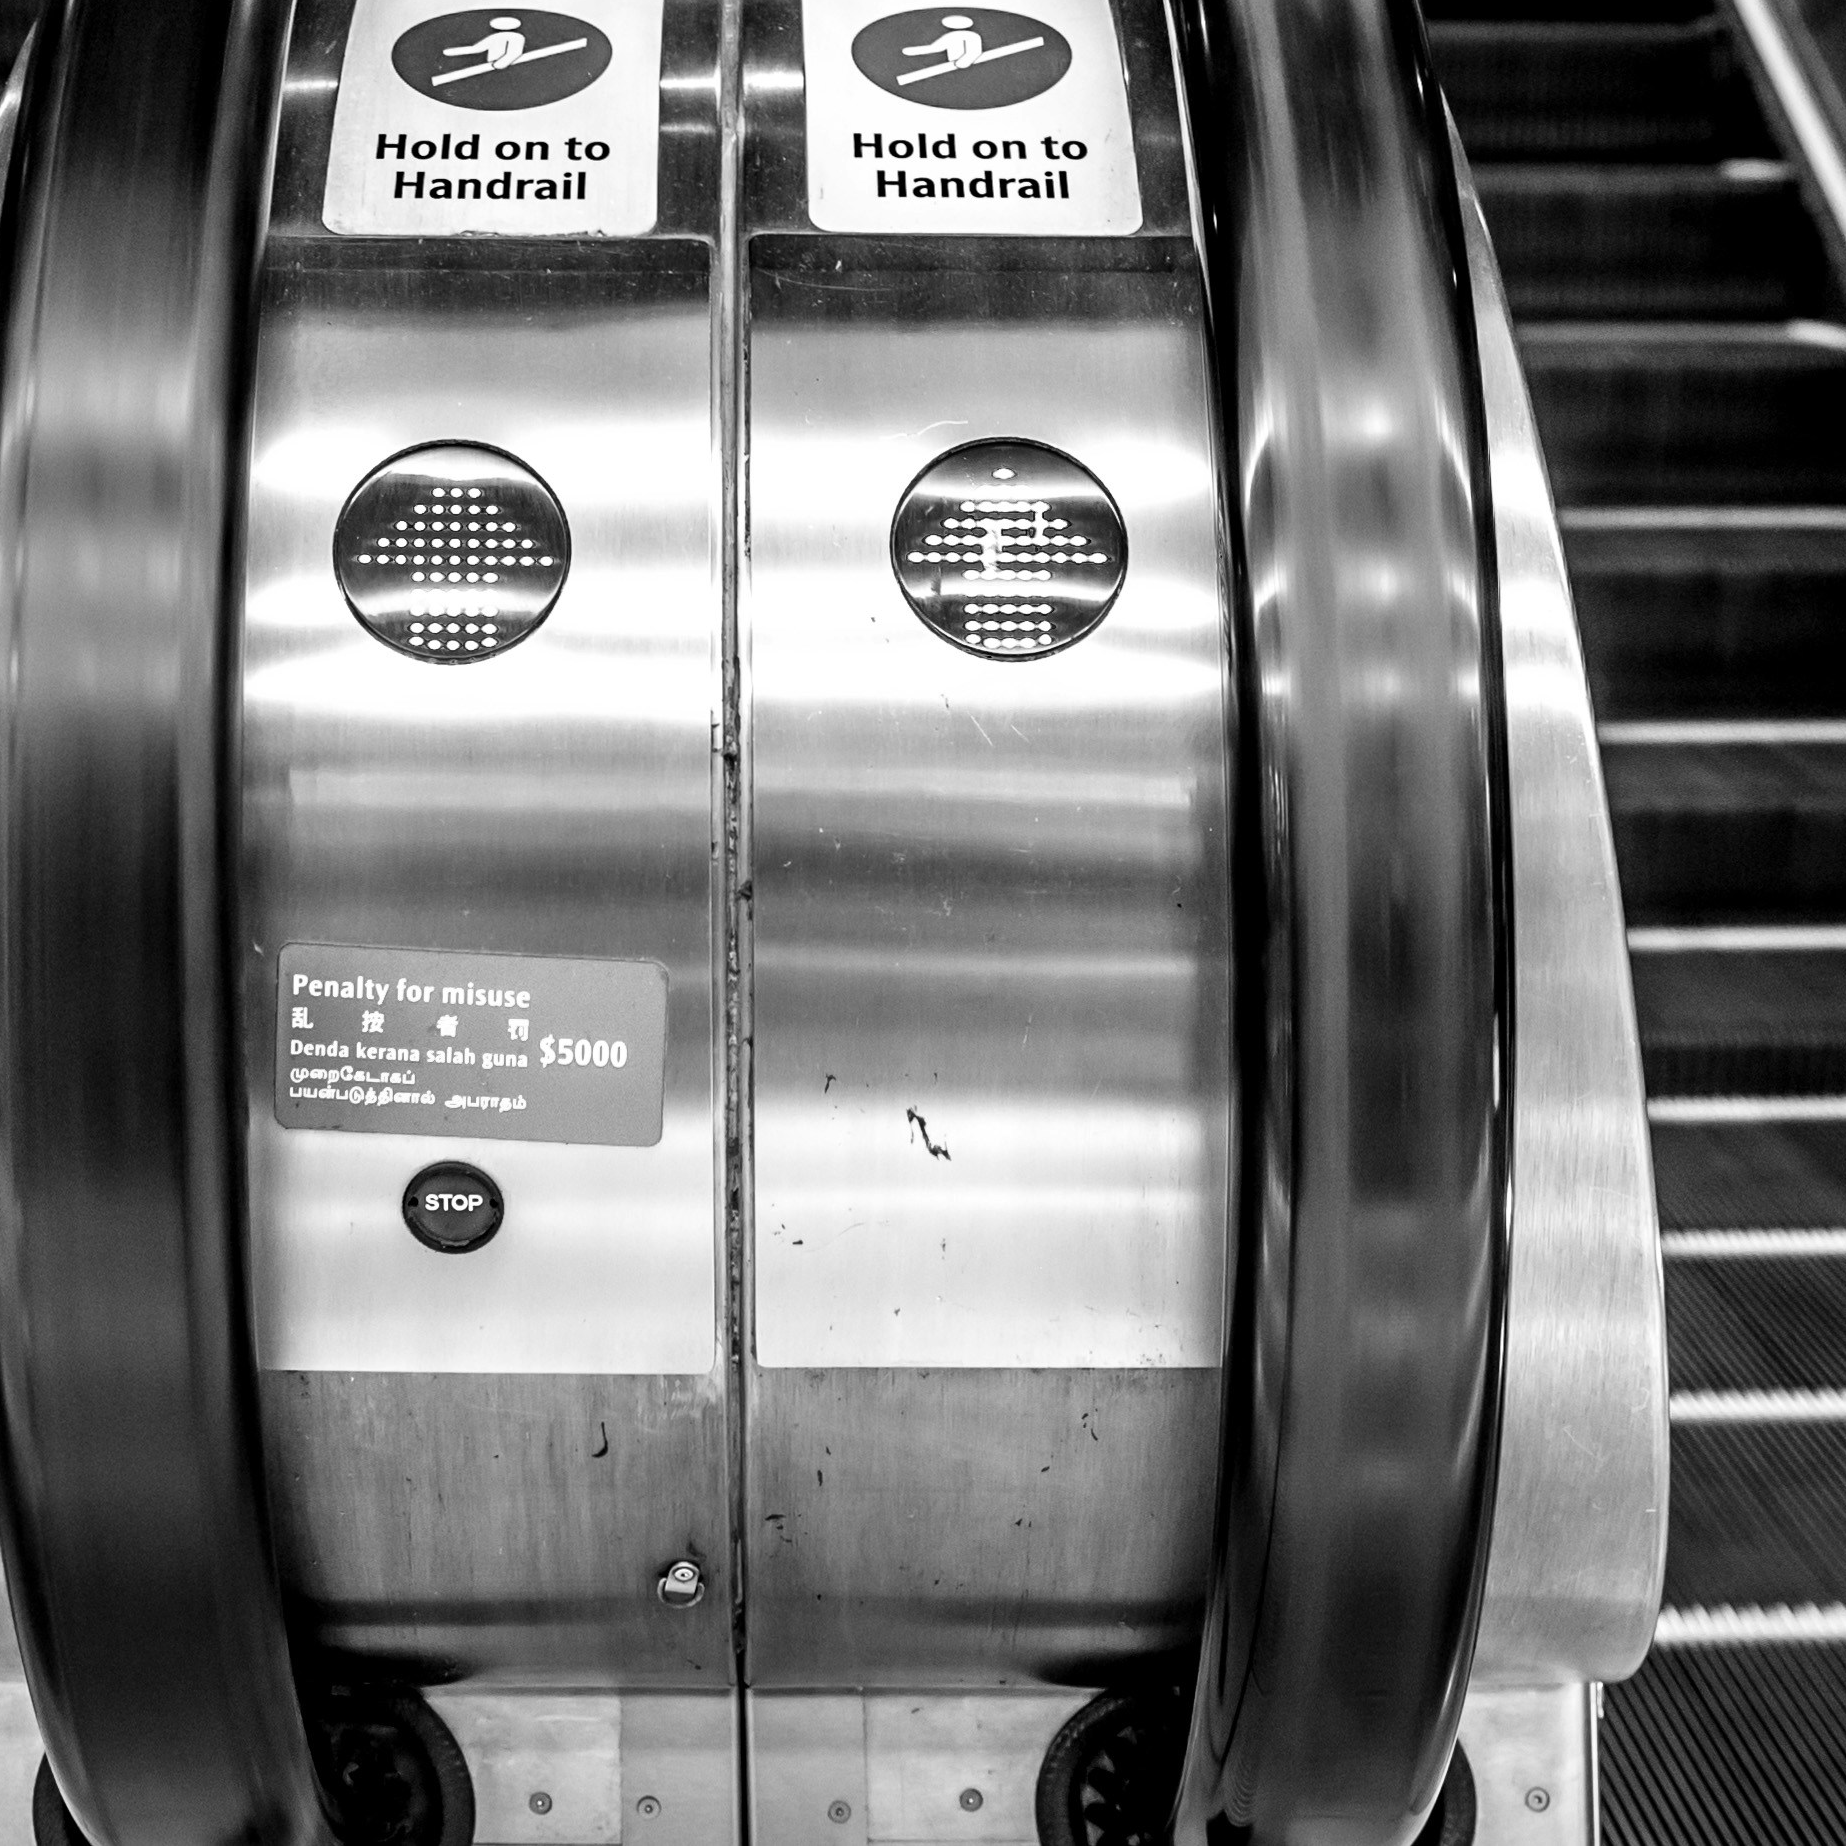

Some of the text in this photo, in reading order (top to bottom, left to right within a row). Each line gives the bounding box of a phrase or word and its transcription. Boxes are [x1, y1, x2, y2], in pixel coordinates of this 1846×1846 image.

[376, 133, 610, 161] Hold on to
[853, 133, 1088, 160] Hold on to
[394, 171, 586, 200] Handrail
[876, 170, 1069, 199] Handrail
[293, 973, 531, 1009] Penalty for misuse
[290, 1039, 528, 1070] Denda kerana salah guna
[539, 1033, 628, 1069] $5000
[425, 1193, 483, 1212] STOP
